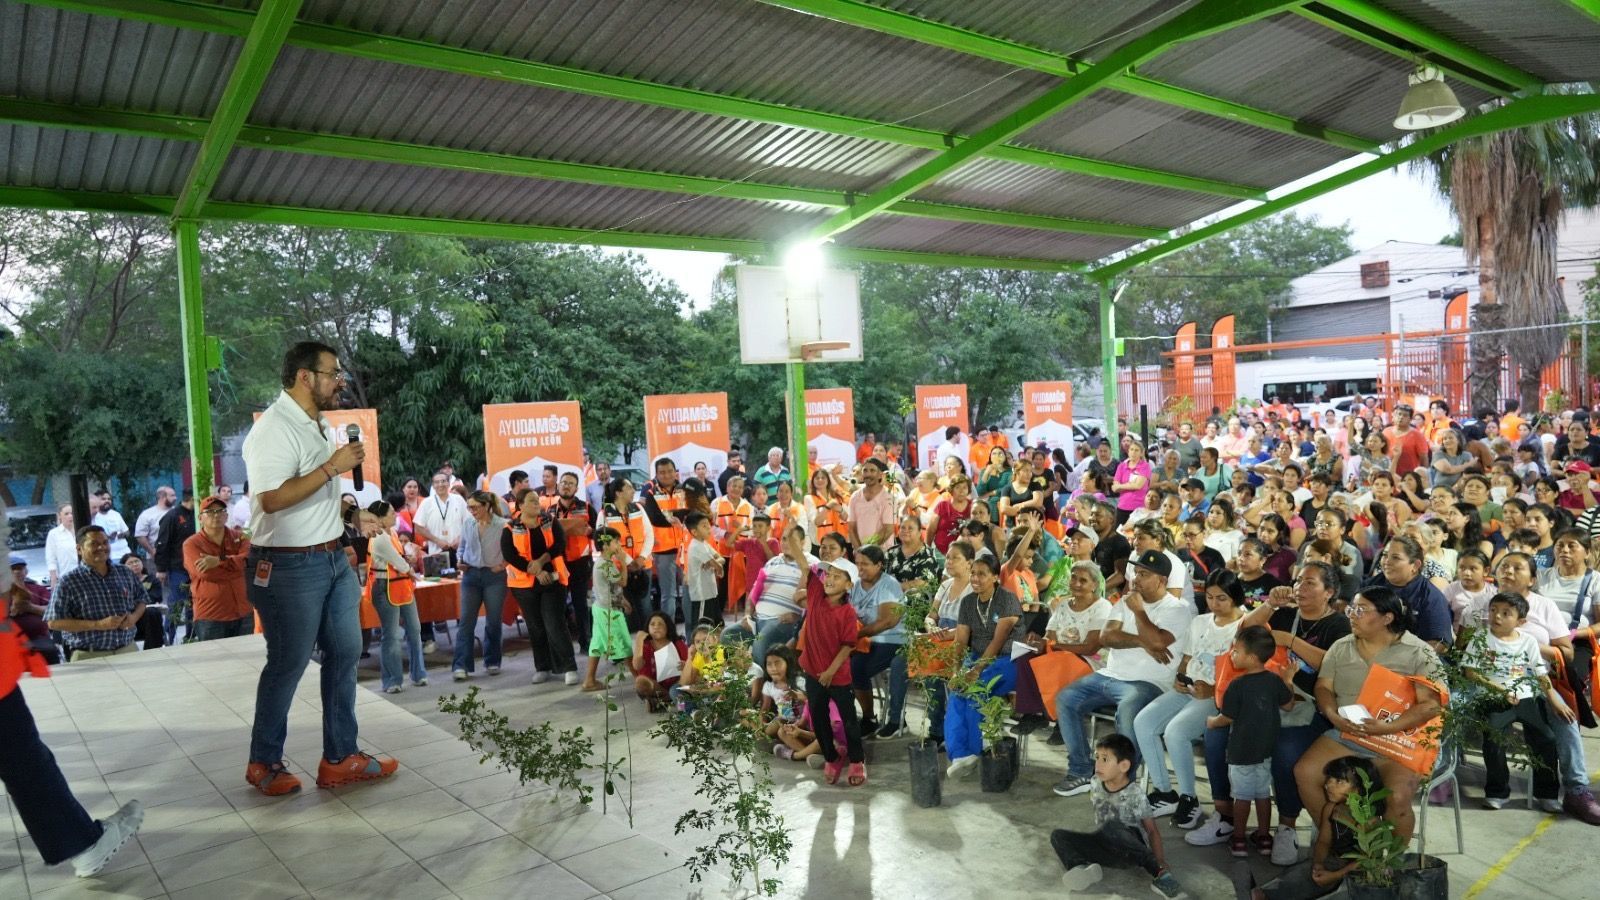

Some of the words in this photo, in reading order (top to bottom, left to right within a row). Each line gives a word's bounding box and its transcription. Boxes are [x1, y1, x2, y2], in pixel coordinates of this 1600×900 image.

[666, 424, 691, 435] NUEVO
[692, 421, 711, 433] LEÓN
[509, 437, 537, 448] NUEVO
[540, 433, 562, 447] LEÓN
